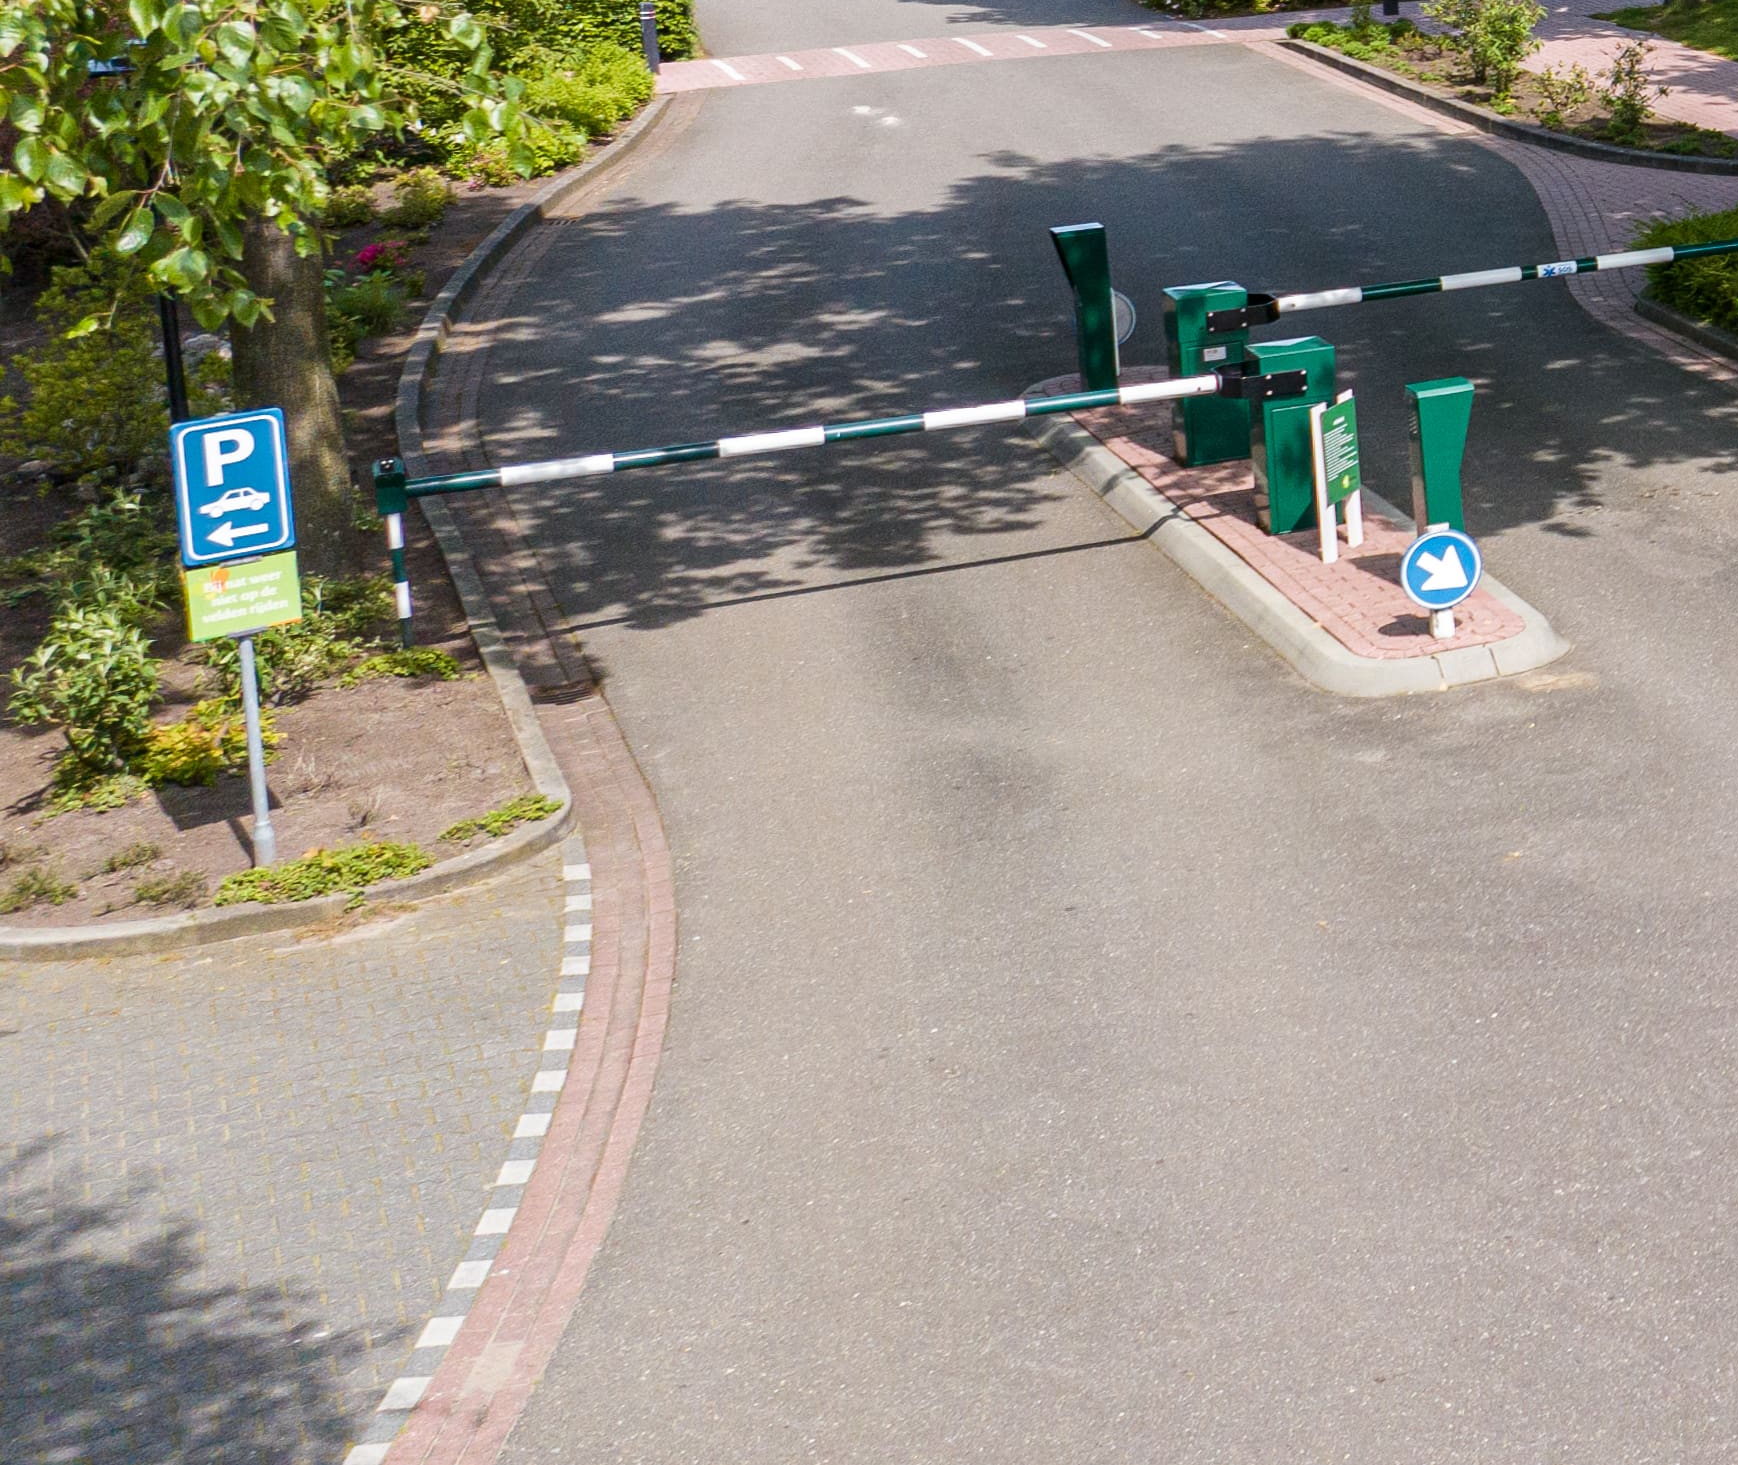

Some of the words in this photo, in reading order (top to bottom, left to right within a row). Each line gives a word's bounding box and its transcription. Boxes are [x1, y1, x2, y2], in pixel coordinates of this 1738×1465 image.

[203, 428, 255, 487] P
[240, 591, 258, 602] op
[260, 586, 278, 597] de
